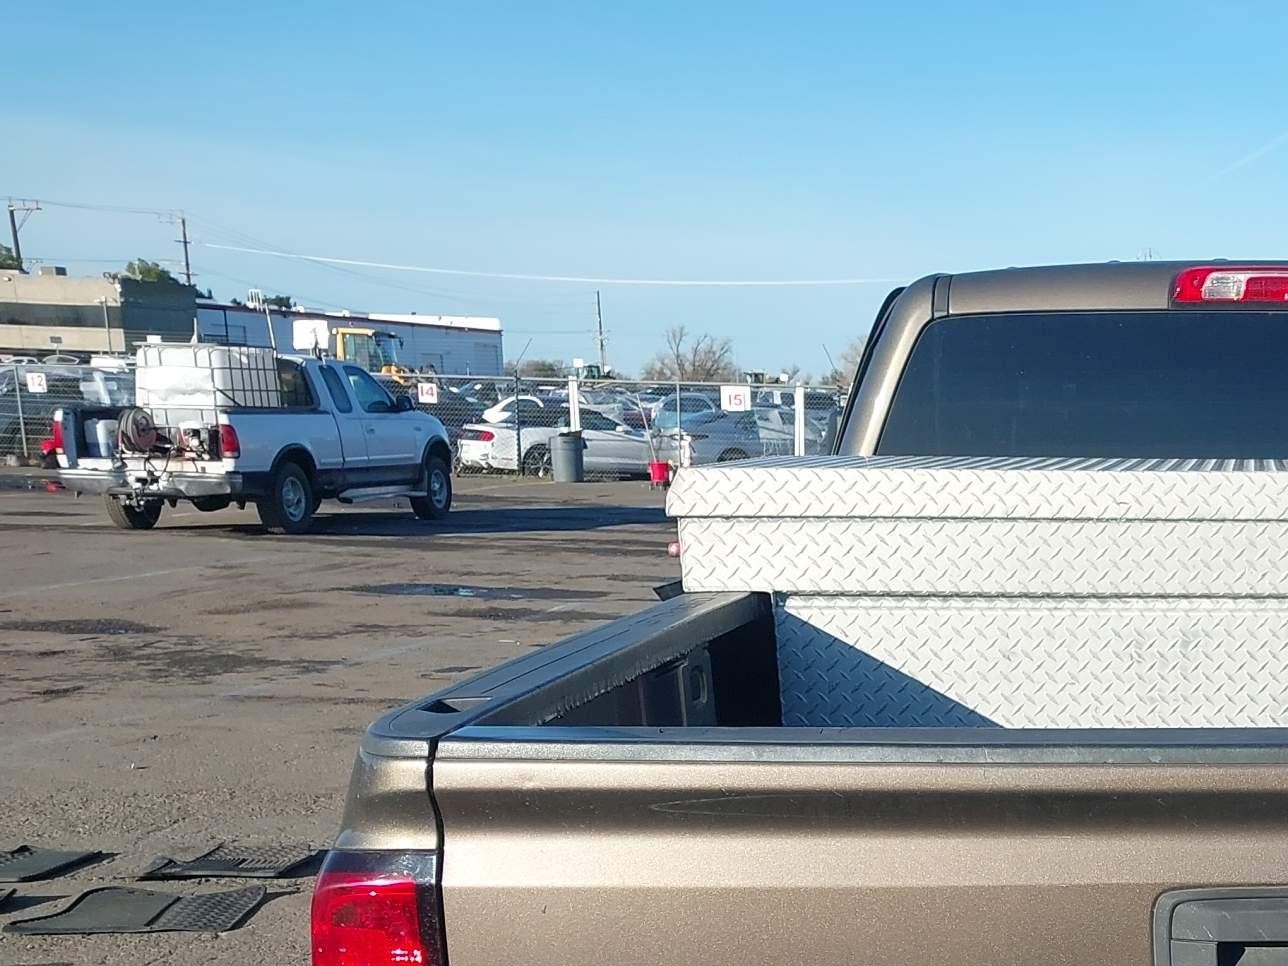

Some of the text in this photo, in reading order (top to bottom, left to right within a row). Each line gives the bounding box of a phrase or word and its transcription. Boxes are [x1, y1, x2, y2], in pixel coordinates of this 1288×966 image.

[31, 375, 44, 387] 12
[420, 385, 435, 398] 14
[728, 393, 743, 407] 15
